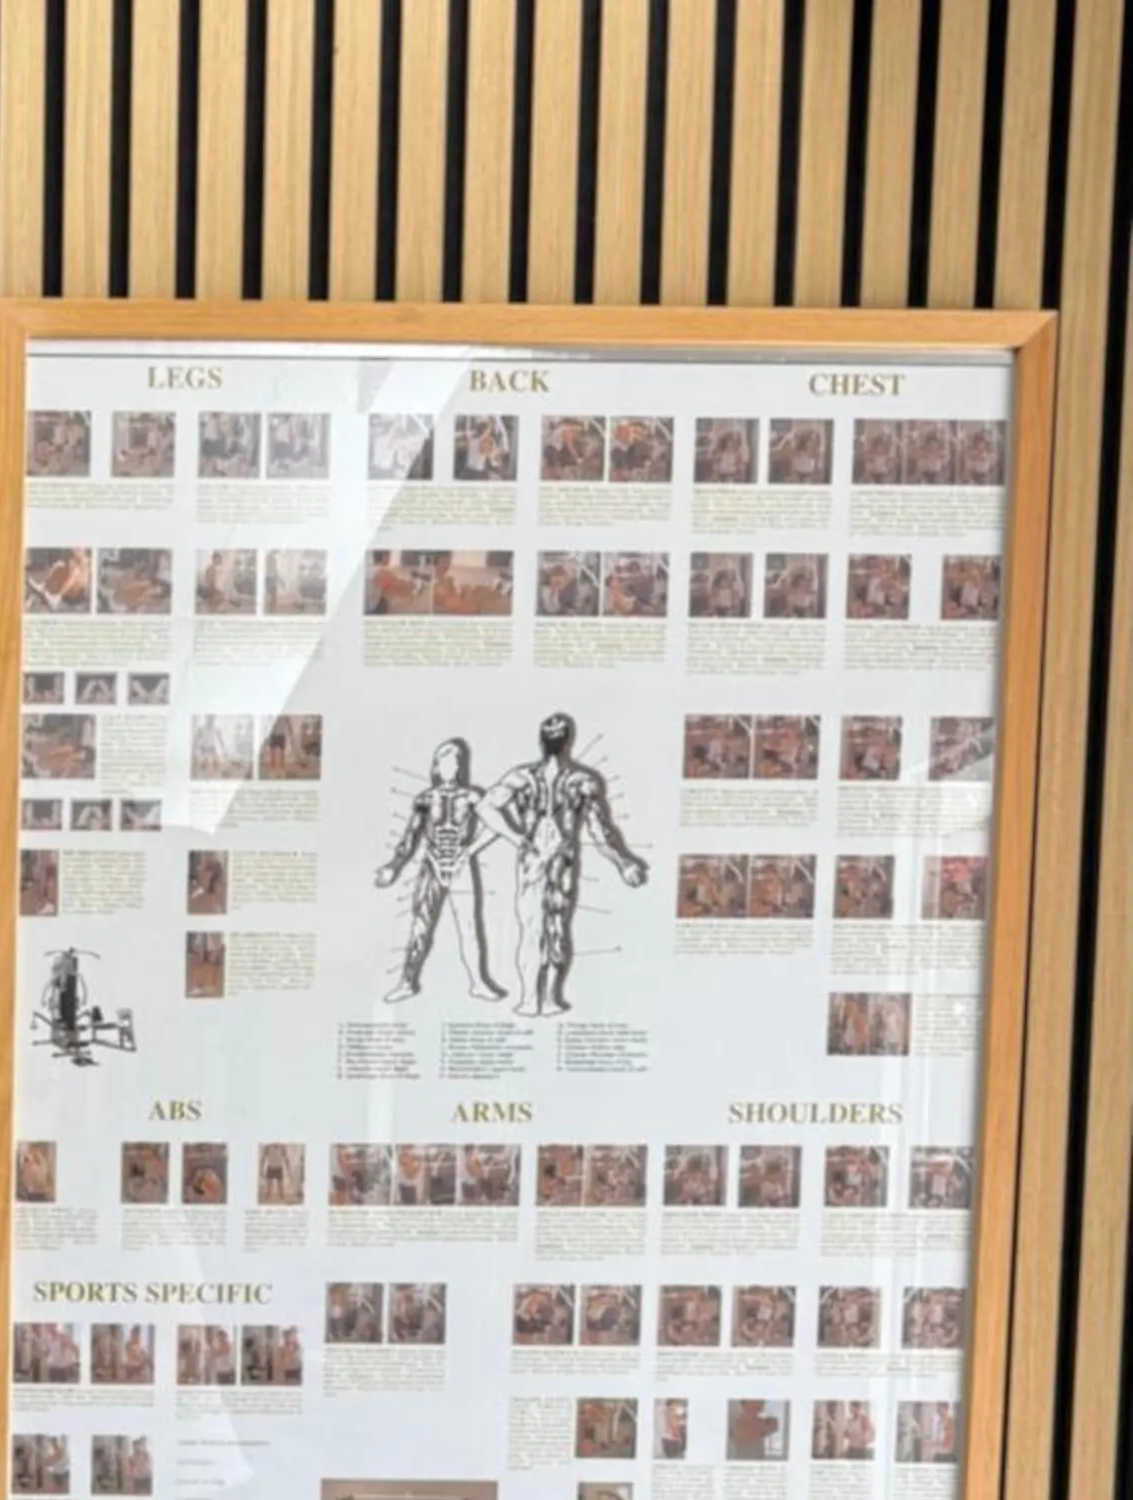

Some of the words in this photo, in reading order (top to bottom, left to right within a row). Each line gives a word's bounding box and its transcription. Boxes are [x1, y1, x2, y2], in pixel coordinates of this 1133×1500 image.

[147, 365, 223, 390] LEGS
[469, 368, 550, 393] BACK
[808, 372, 906, 397] CHEST
[148, 1099, 203, 1122] ABS
[453, 1101, 533, 1124] ARMS
[728, 1101, 903, 1125] SHOULDERS
[33, 1280, 139, 1303] SPORTS
[144, 1282, 273, 1305] SPECIFIC
